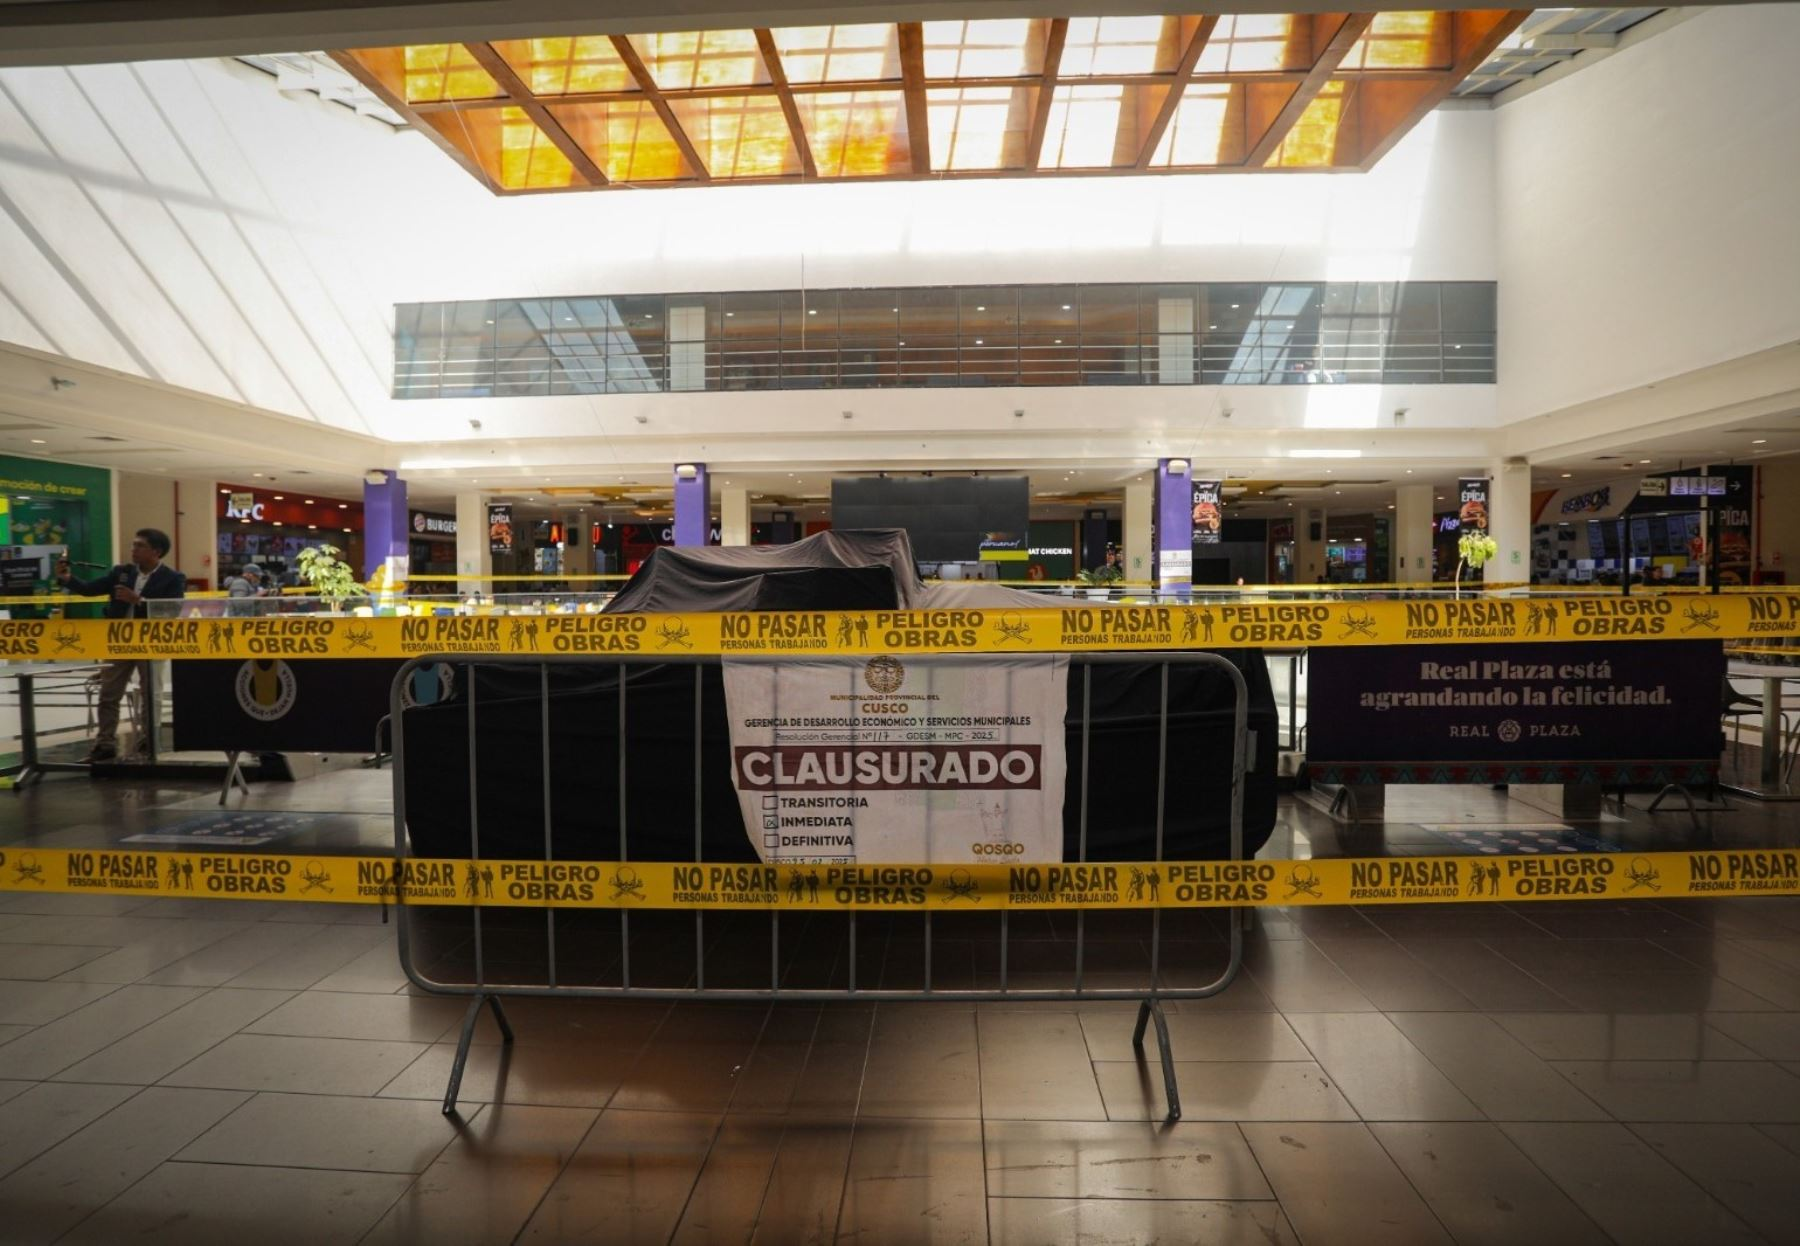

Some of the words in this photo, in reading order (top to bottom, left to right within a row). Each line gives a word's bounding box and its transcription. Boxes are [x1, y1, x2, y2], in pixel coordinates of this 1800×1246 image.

[1222, 606, 1329, 623] PELIGRO
[1406, 603, 1438, 627] NO
[1446, 602, 1516, 627] PASAR
[1565, 600, 1672, 616] PELIGRO
[1748, 596, 1782, 620] NO
[241, 620, 334, 636] PELIGRO
[546, 617, 646, 632] PELIGRO
[721, 616, 750, 638] NO
[758, 615, 826, 638] PASAR
[876, 612, 984, 628] PELIGRO
[1062, 609, 1094, 633] NO
[1102, 609, 1171, 633] PASAR
[1572, 617, 1665, 635] OBRAS
[1748, 622, 1796, 632] PERSONAS
[0, 622, 45, 638] GRO
[108, 621, 134, 643] NO
[140, 621, 198, 643] PASAR
[402, 618, 428, 641] NO
[436, 618, 499, 641] PASAR
[1230, 624, 1322, 642] OBRAS
[1406, 629, 1453, 638] PERSONAS
[0, 639, 39, 655] RAS
[249, 637, 329, 654] OBRAS
[553, 634, 640, 651] OBRAS
[720, 640, 766, 650] PERSONAS
[885, 630, 976, 647] OBRAS
[1061, 635, 1109, 644] PERSONAS
[108, 645, 148, 654] PERSONAS
[401, 643, 445, 652] PERSONAS
[1420, 661, 1477, 680] Real
[1483, 661, 1554, 680] Plaza
[1559, 660, 1612, 679] está
[1360, 687, 1518, 710] agrandando
[1523, 686, 1547, 705] la
[1551, 685, 1672, 706] felicidad.
[862, 703, 908, 714] CUSCO
[745, 719, 788, 727] GERENCIA
[790, 718, 801, 727] DE
[804, 718, 860, 727] DESARROLLO
[862, 715, 917, 727] ECONÓMICO
[918, 717, 925, 726] Y
[927, 717, 972, 726] SERVICIOS
[974, 717, 1031, 726] MUNICIPALES
[776, 732, 819, 741] Resolución
[821, 732, 860, 741] Gerencial
[906, 732, 936, 740] GDESM
[971, 732, 992, 740] 2025
[1450, 726, 1490, 737] REAL
[1530, 725, 1581, 736] PLAZA
[742, 751, 1035, 785] CLAUSURADO
[781, 797, 868, 808] TRANSITORIA
[781, 816, 853, 827] INMEDIATA
[782, 835, 854, 846] DEFINITIVA
[972, 843, 1024, 854] QOSQO
[68, 853, 93, 876] NO
[100, 854, 157, 877] PASAR
[200, 857, 291, 874] PELIGRO
[358, 861, 386, 884] NO
[392, 862, 455, 886] PASAR
[501, 864, 600, 881] PELIGRO
[1168, 865, 1275, 882] PELIGRO
[1508, 859, 1613, 876] PELIGRO
[1690, 855, 1721, 880] NO
[1728, 853, 1797, 879] PASAR
[67, 878, 107, 887] PERSONAS
[673, 867, 703, 890] NO
[710, 867, 777, 891] PASAR
[827, 868, 933, 885] PELIGRO
[1009, 867, 1041, 891] NO
[1050, 867, 1118, 891] PASAR
[1352, 862, 1382, 887] NO
[1388, 861, 1458, 886] PASAR
[207, 876, 286, 893] OBRAS
[508, 883, 594, 900] OBRAS
[1175, 884, 1268, 900] OBRAS
[1350, 888, 1397, 898] PERSONAS
[1515, 877, 1606, 895] OBRAS
[1689, 881, 1736, 891] PERSONAS
[673, 892, 718, 902] PERSONAS
[834, 886, 926, 904] OBRAS
[1009, 893, 1056, 903] PERSONAS
